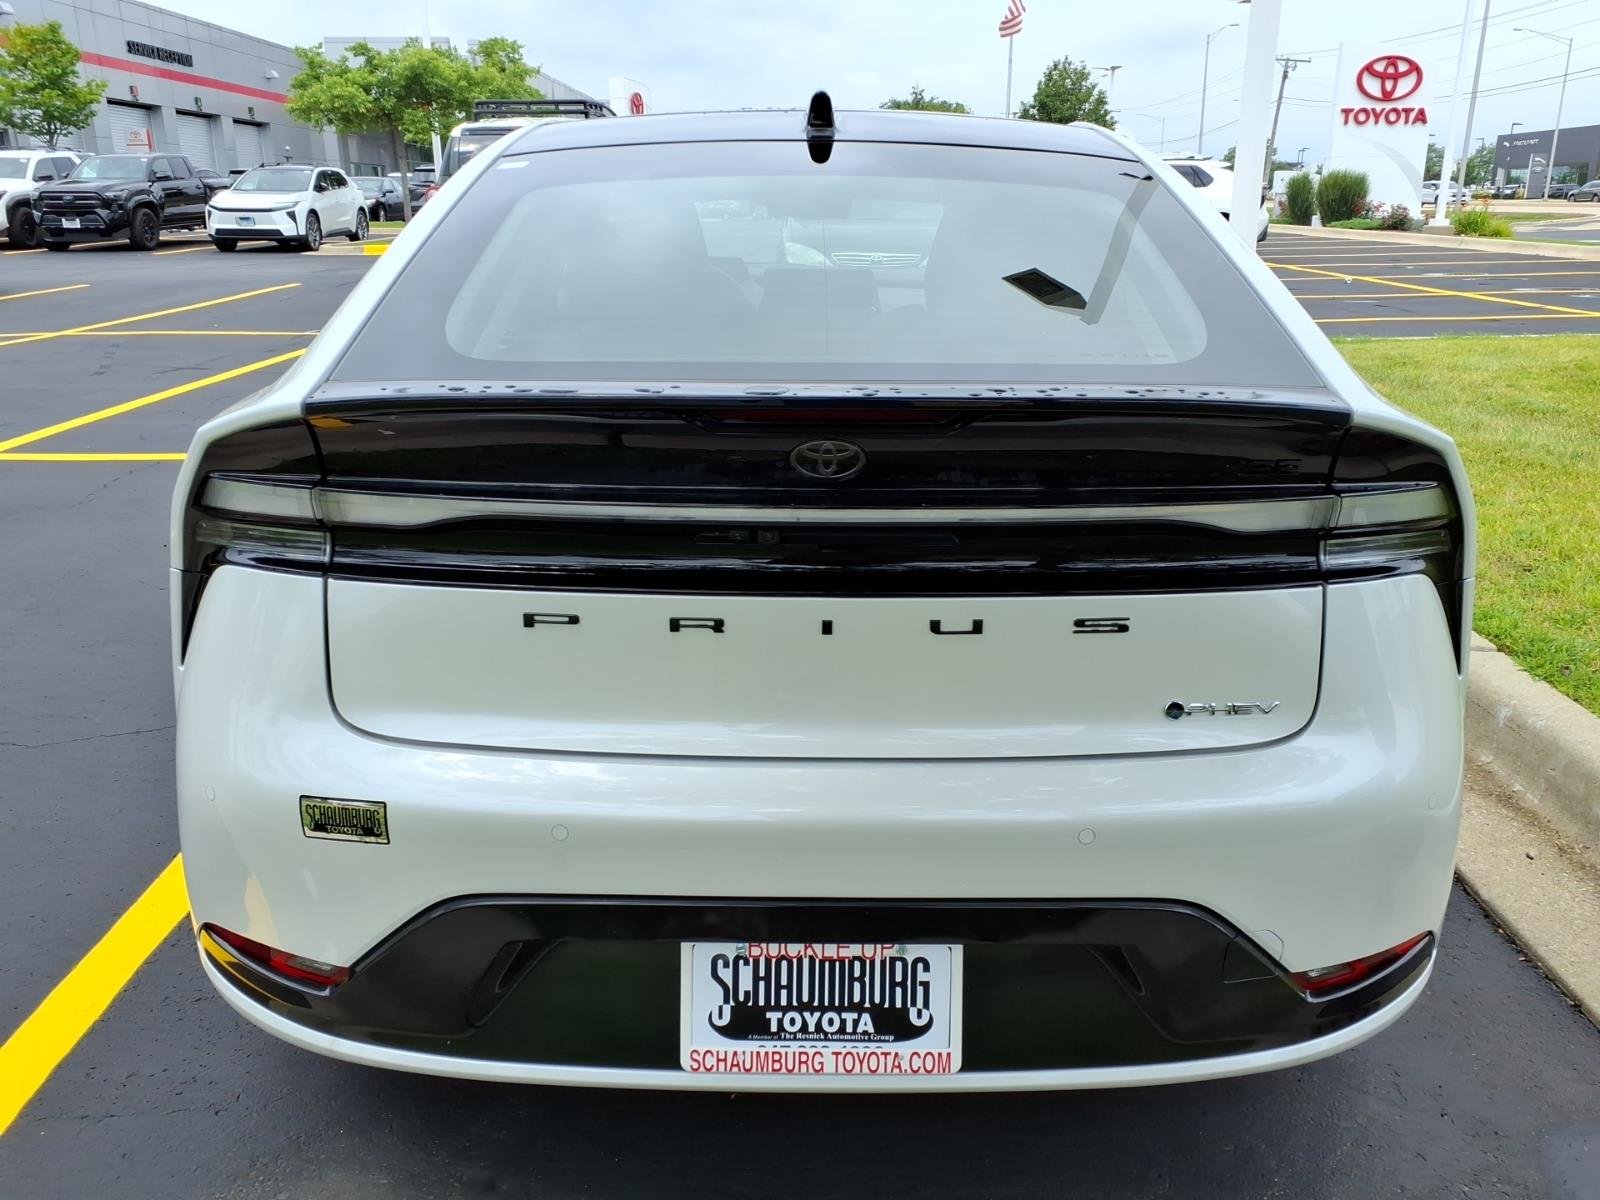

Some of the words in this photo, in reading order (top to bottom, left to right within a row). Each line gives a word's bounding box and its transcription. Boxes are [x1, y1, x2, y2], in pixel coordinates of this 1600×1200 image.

[1340, 107, 1428, 126] TOYOTA
[523, 612, 1130, 634] PRIUS
[305, 804, 382, 834] SCHAUMBURG
[326, 825, 365, 836] TOYOTA
[748, 943, 852, 960] BUCKLE
[861, 943, 895, 961] UP
[711, 953, 931, 1027] SCHAUMBURG
[766, 1011, 875, 1033] TOYOTA
[796, 1032, 825, 1040] Resnick
[827, 1033, 869, 1041] Automotive
[870, 1033, 895, 1042] Group
[690, 1050, 824, 1073] SCHAUMBURG
[832, 1051, 951, 1074] TOYOTA.COM
